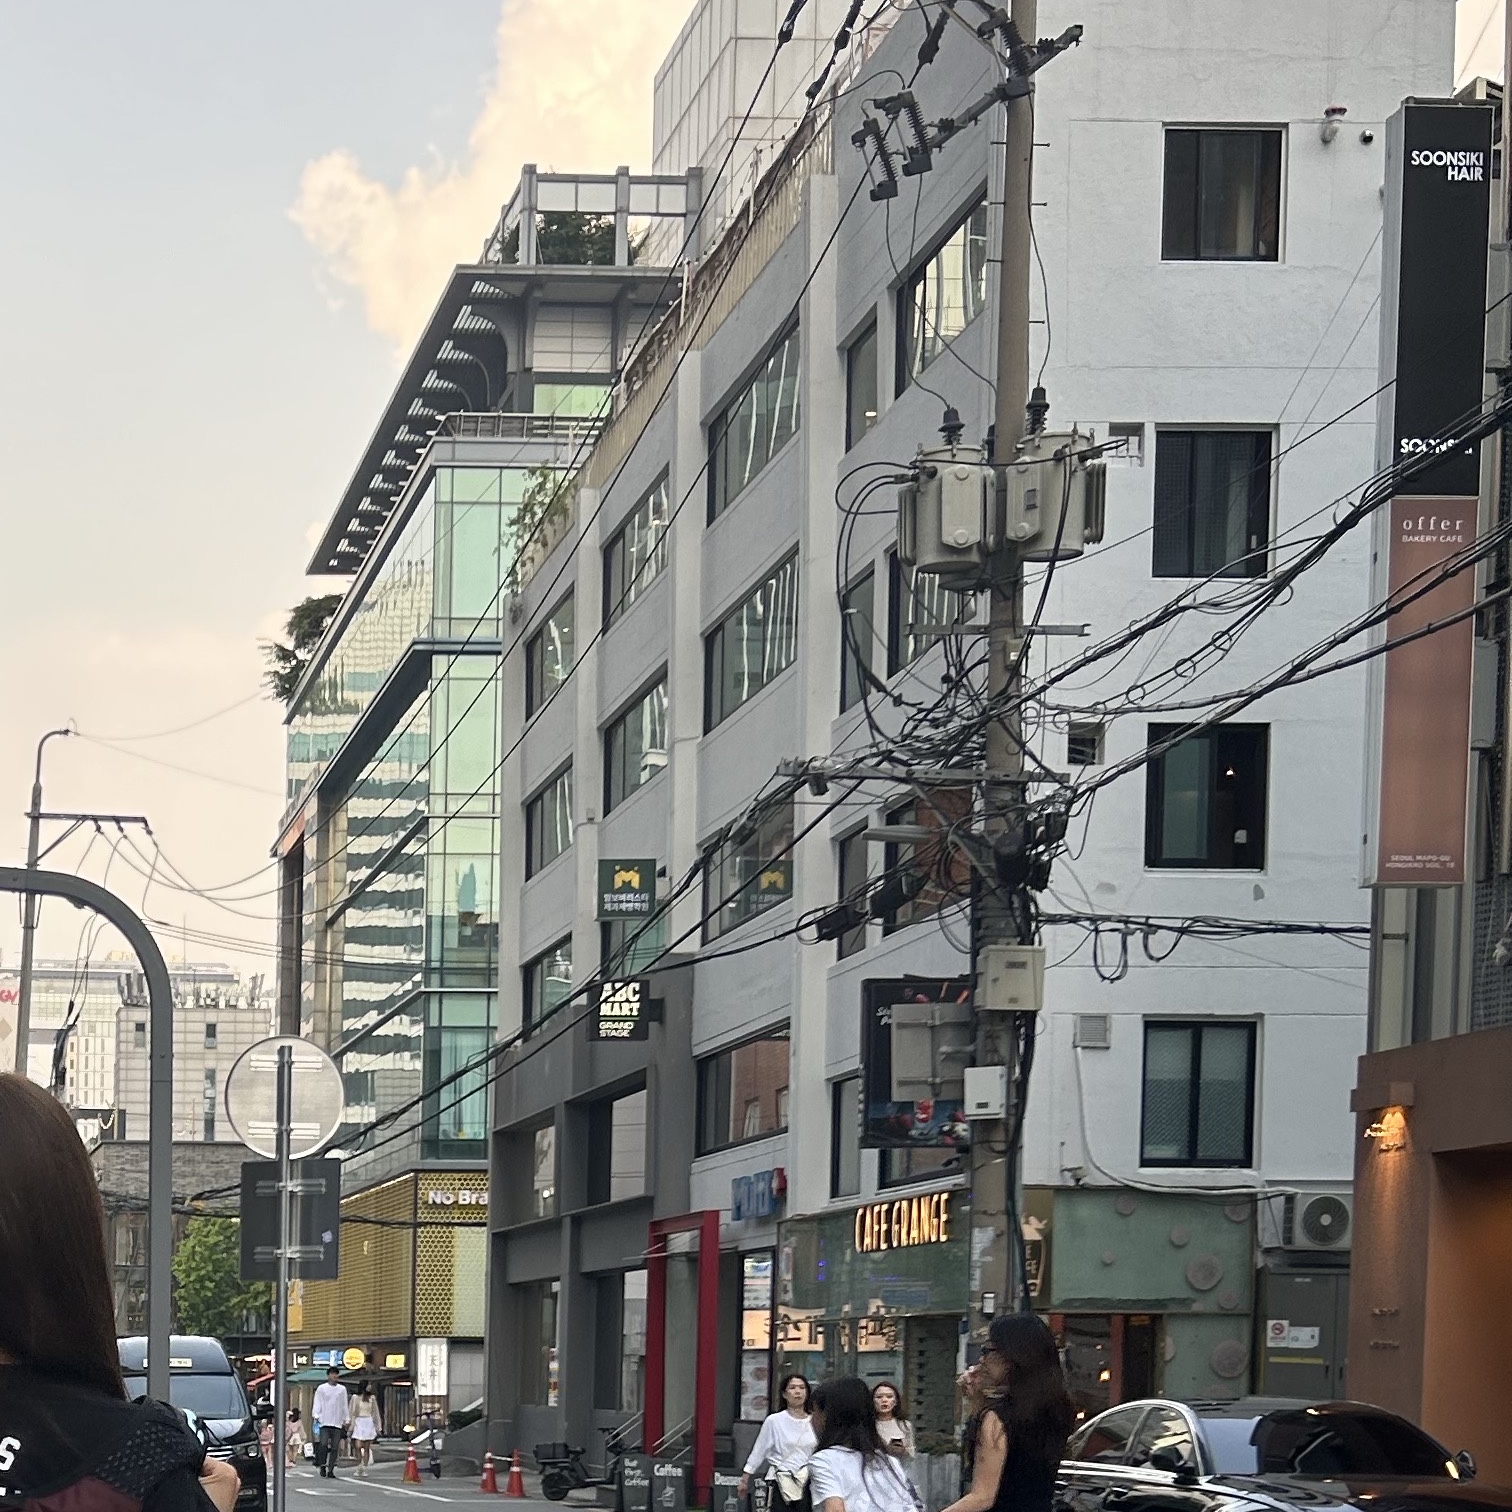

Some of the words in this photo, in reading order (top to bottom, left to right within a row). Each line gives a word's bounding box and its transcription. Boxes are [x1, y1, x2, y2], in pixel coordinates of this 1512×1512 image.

[1411, 150, 1484, 166] SOONSIKI
[1447, 166, 1484, 181] HAIR
[1402, 516, 1464, 531] offer
[1402, 535, 1437, 543] BAKERY
[1439, 535, 1463, 543] CAFE
[599, 982, 640, 1002] ABC
[599, 1002, 641, 1016] MART
[599, 1021, 634, 1030] GRAND
[599, 1029, 630, 1038] STAGE
[427, 1190, 455, 1206] No
[855, 1203, 889, 1254] CAFE
[653, 1463, 683, 1477] Coffee
